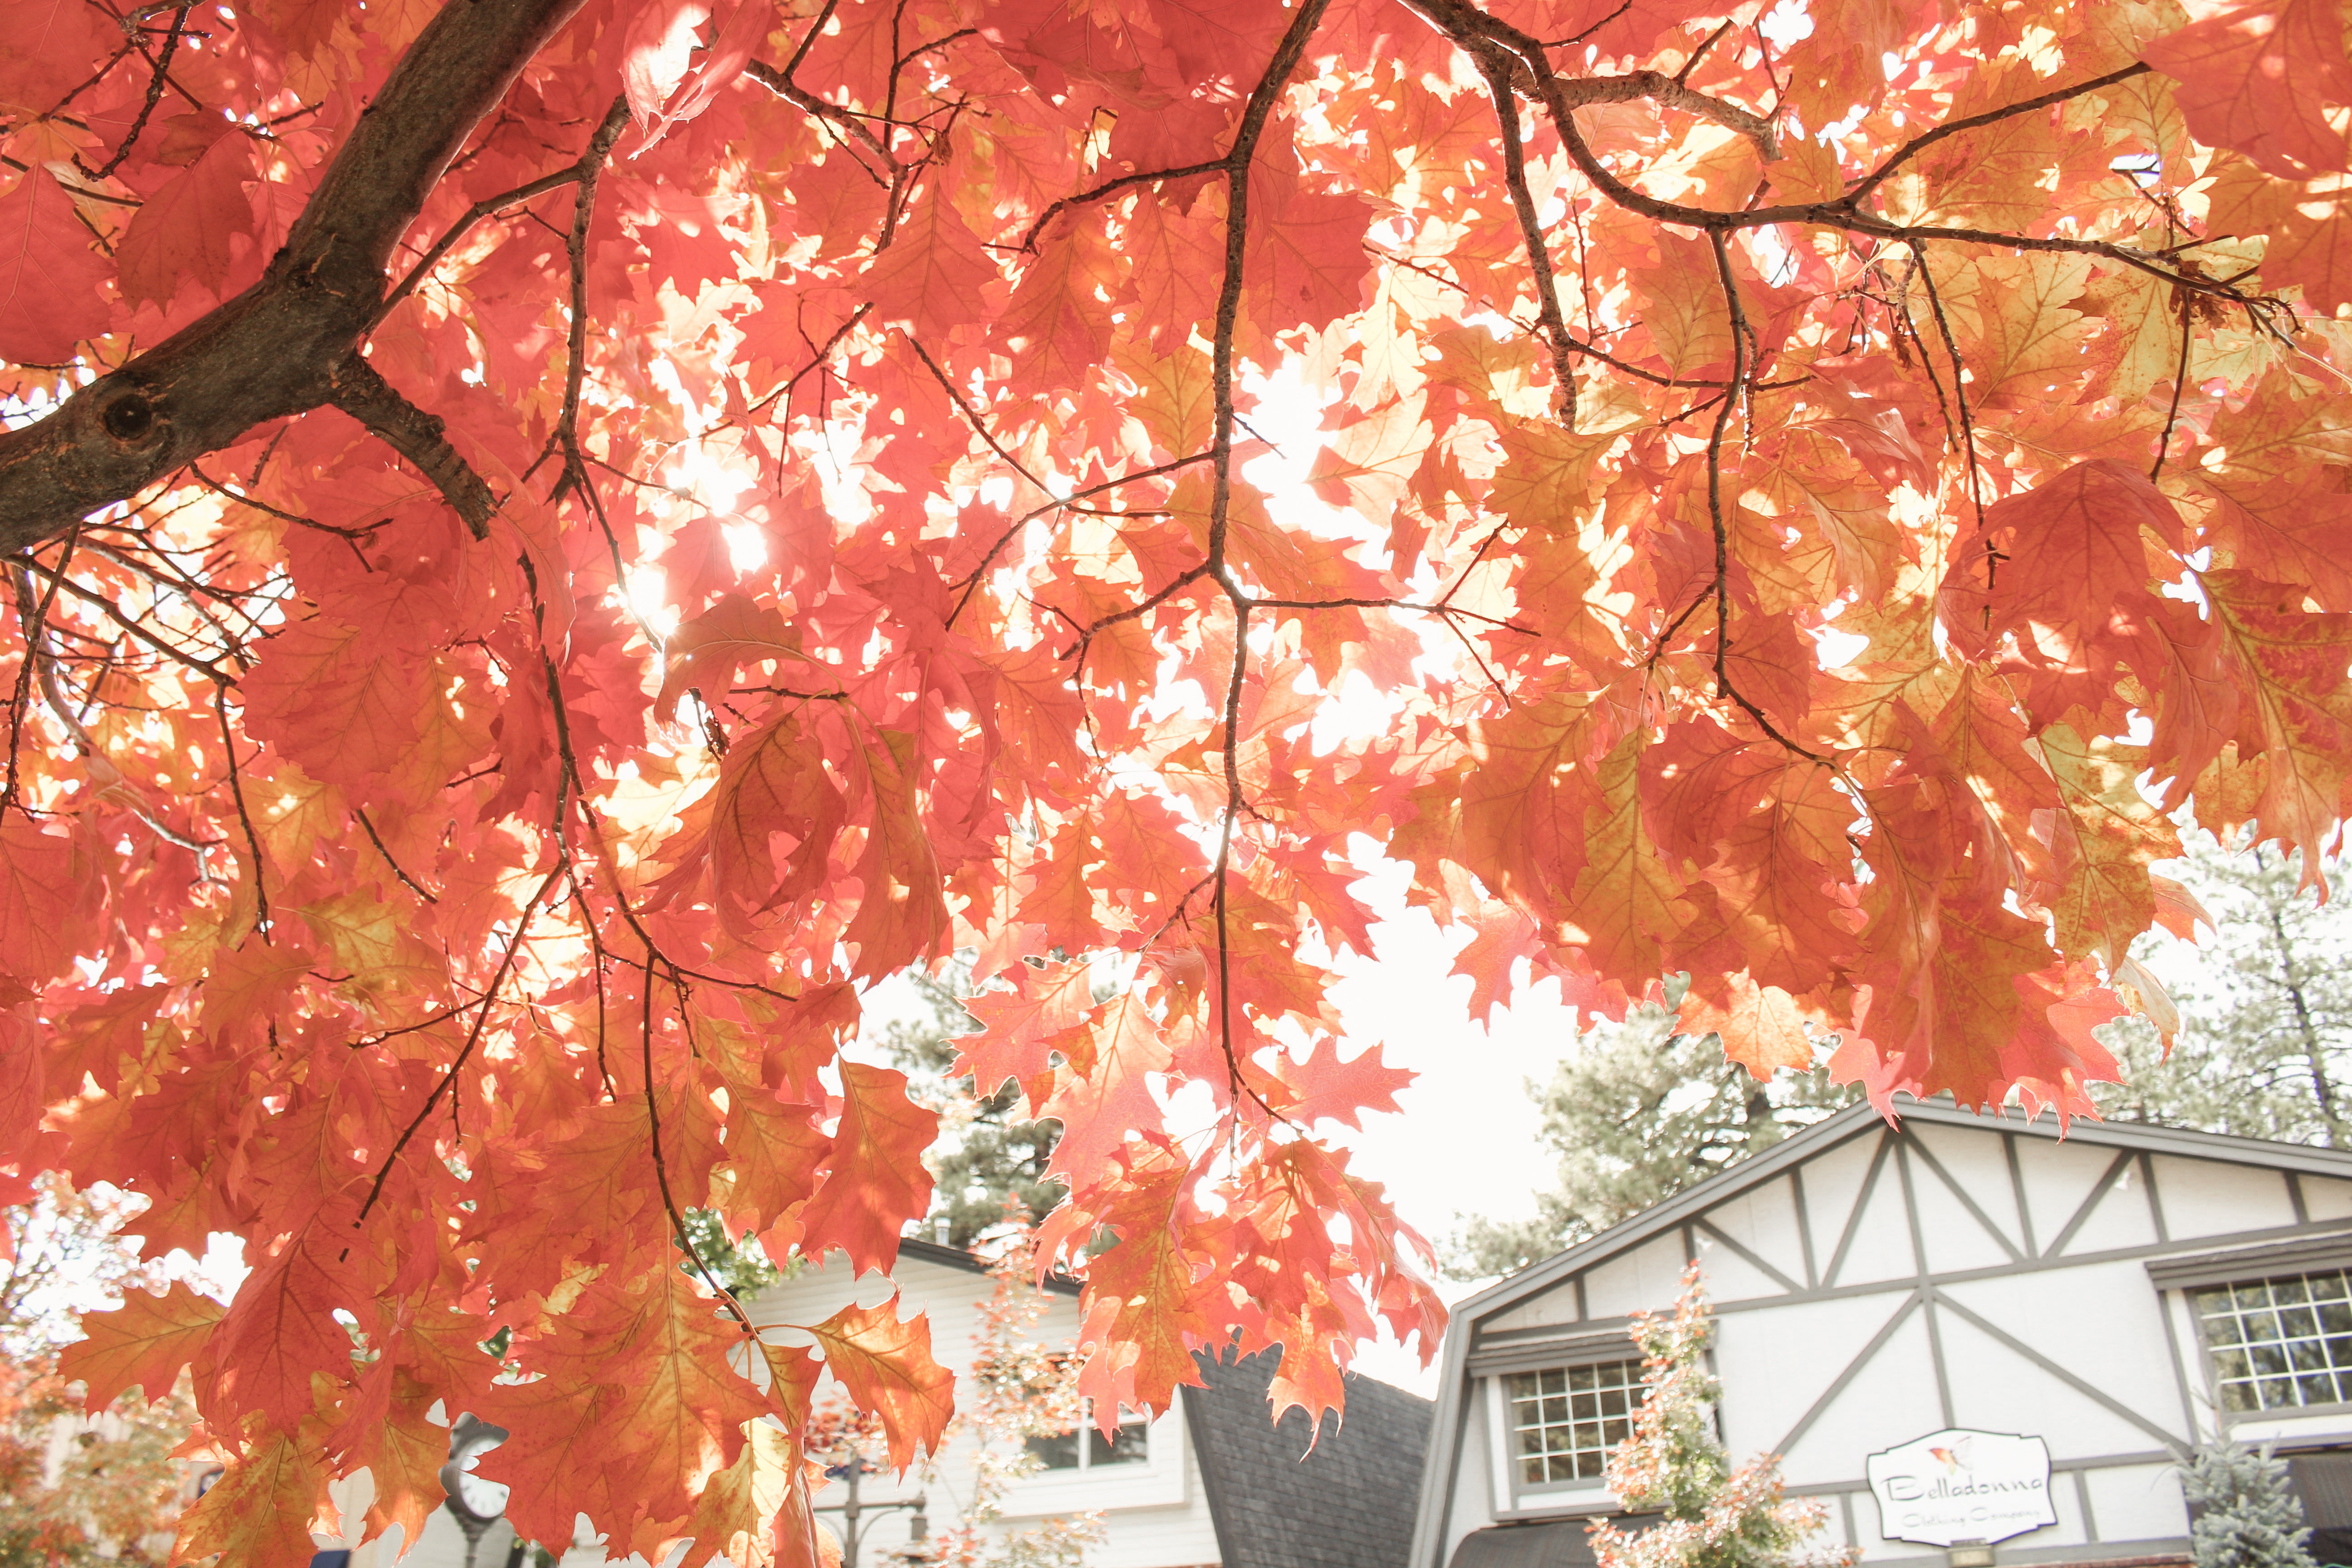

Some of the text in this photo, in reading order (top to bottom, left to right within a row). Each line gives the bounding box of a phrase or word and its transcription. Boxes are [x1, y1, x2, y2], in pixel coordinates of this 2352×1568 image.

[1880, 1475, 2043, 1501] Belladonna
[1902, 1506, 2041, 1528] Clothing Company
